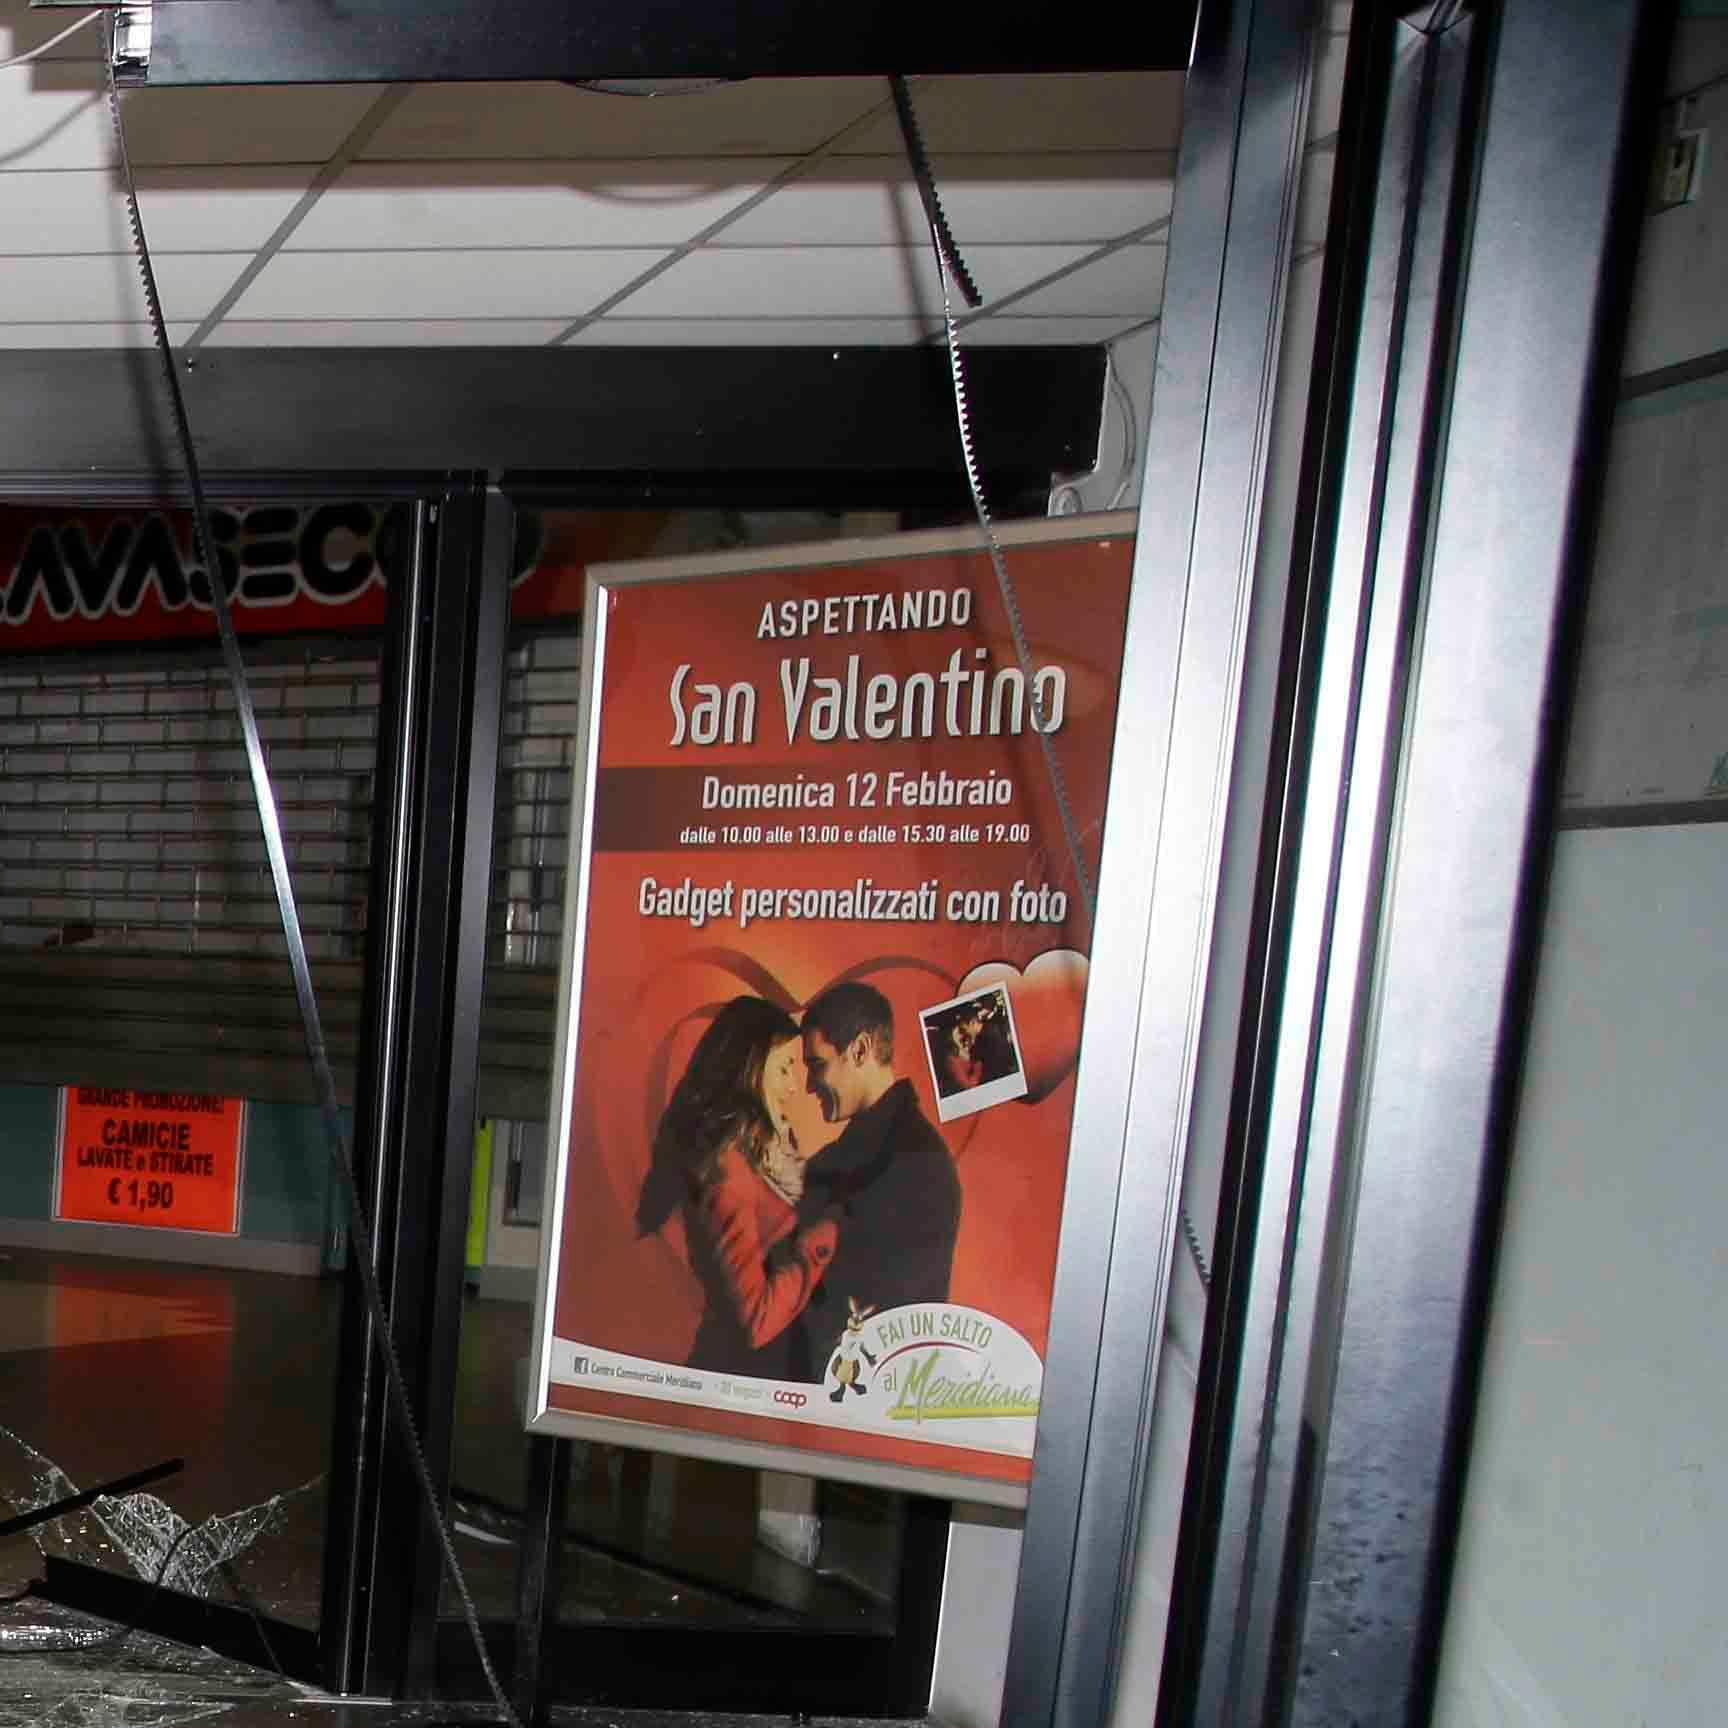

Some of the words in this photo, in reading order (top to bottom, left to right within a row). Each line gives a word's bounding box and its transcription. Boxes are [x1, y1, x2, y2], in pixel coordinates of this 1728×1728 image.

[757, 587, 972, 639] ASPETTANDO
[669, 663, 757, 746] San
[779, 647, 1067, 745] Valentino
[702, 773, 834, 810] Domenica
[845, 772, 877, 808] 12
[884, 769, 1013, 807] Febbraio
[679, 825, 717, 844] dalle
[720, 825, 762, 844] 10.00
[765, 824, 793, 844] alle
[798, 824, 840, 843] 13.00
[843, 830, 854, 843] e
[857, 824, 897, 843] dalle
[901, 824, 945, 843] 15.30
[949, 823, 980, 843] alle
[984, 822, 1030, 843] 19.00
[638, 876, 734, 927] Gadget
[739, 879, 938, 928] personalizzati
[946, 888, 1001, 922] con
[1009, 879, 1068, 923] foto
[102, 1118, 191, 1151] CAMICIE
[77, 1146, 132, 1170] LAVATE
[149, 1151, 214, 1178] STIRATE
[108, 1177, 122, 1206] €
[126, 1178, 174, 1213] 1,90
[876, 1319, 907, 1349] FAI
[910, 1310, 934, 1337] UN
[939, 1312, 993, 1349] SALTO
[590, 1361, 615, 1378] Centro
[882, 1367, 897, 1393] al
[897, 1348, 1039, 1424] Meridiana
[773, 1389, 808, 1409] coop
